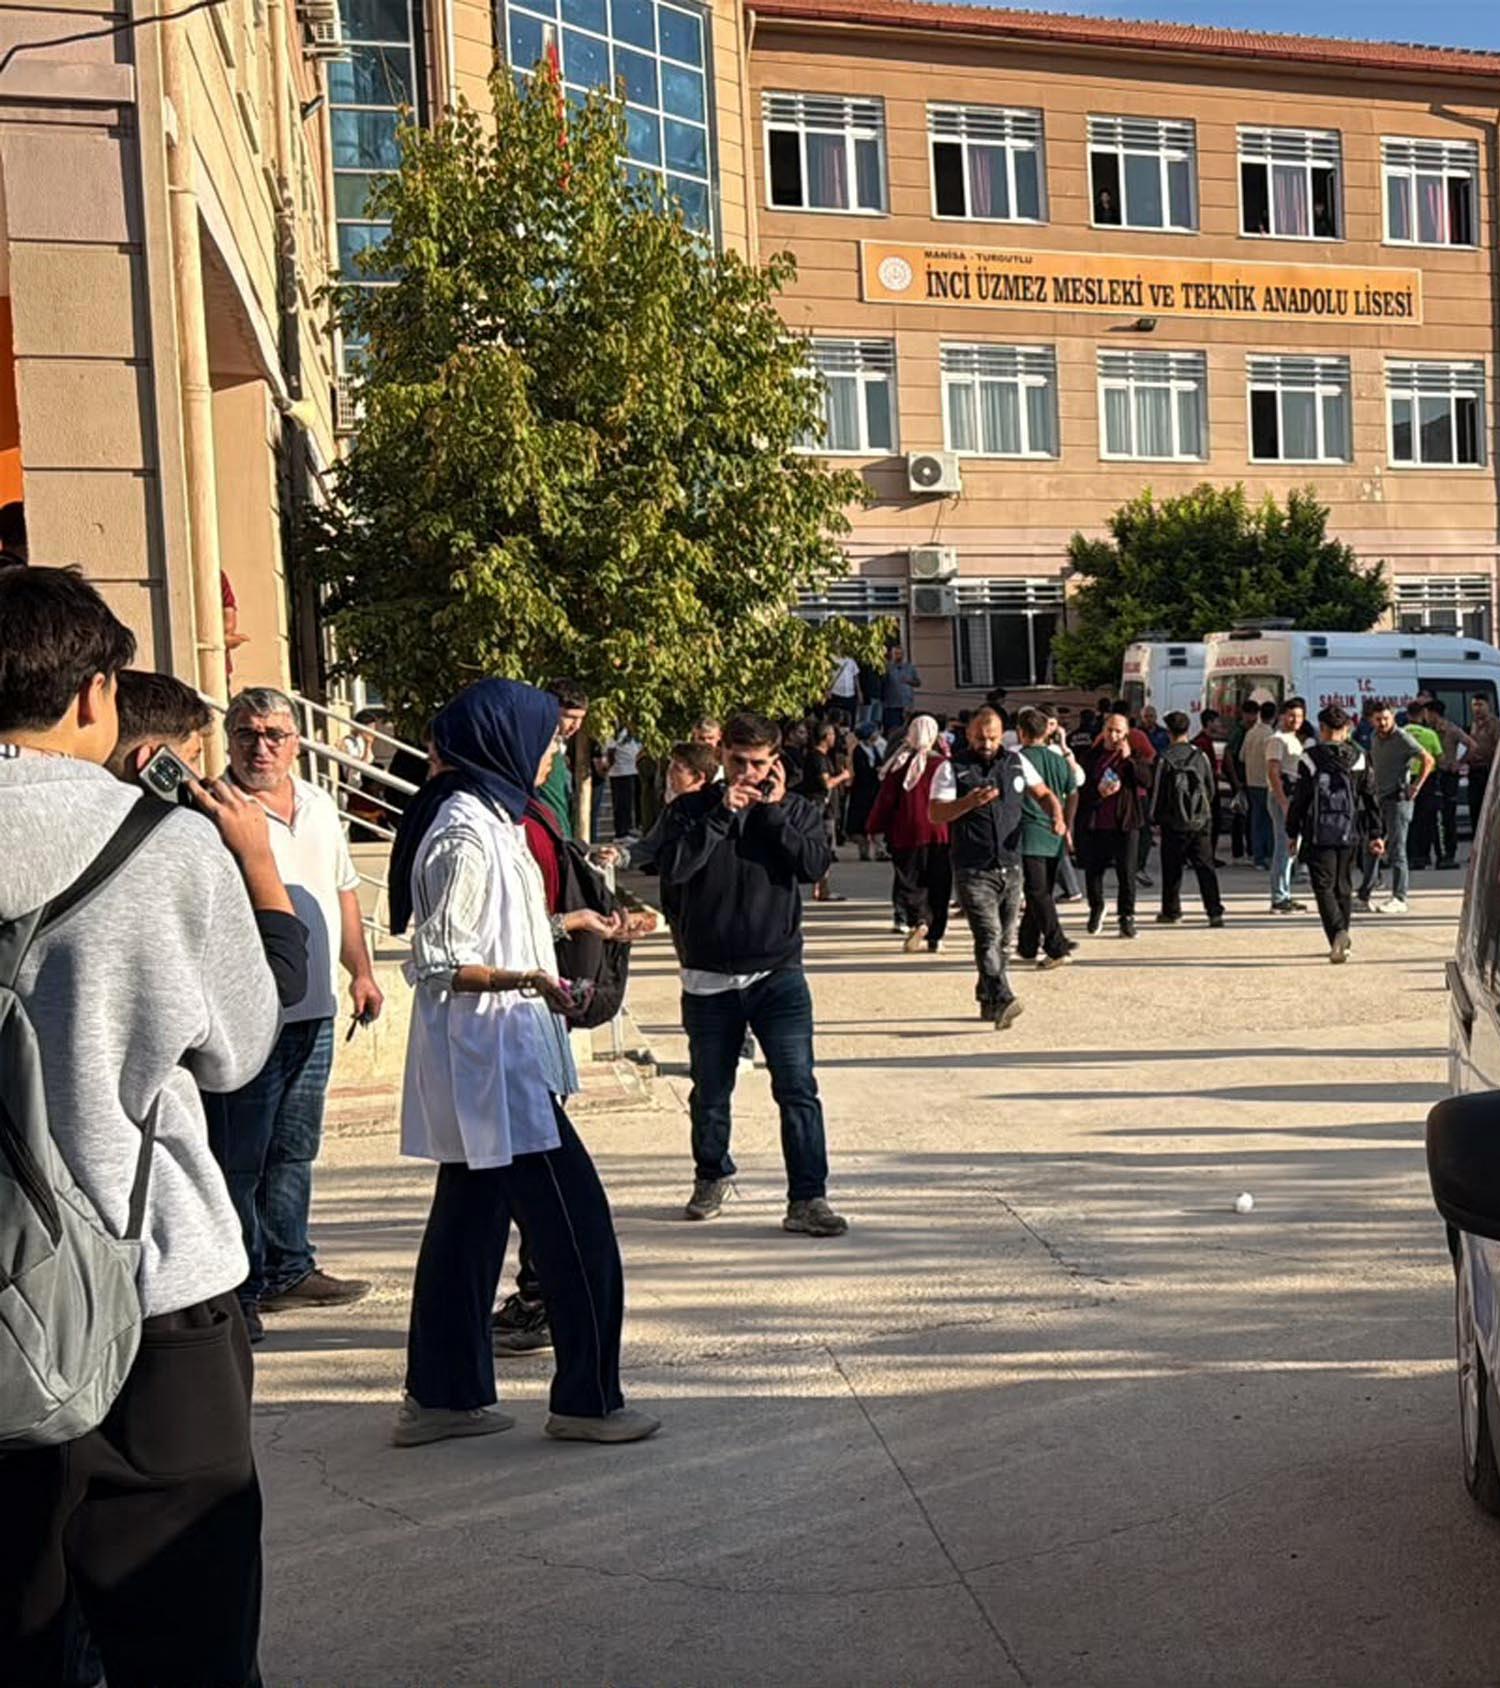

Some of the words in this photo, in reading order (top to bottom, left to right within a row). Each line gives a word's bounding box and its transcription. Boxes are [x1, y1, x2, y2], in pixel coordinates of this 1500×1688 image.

[926, 263, 971, 299] İNCİ
[976, 267, 1048, 303] ÜZMEZ
[1053, 273, 1144, 307] MESLEKİ
[1148, 284, 1175, 308] VE
[1181, 278, 1257, 312] TEKNİK
[1262, 285, 1349, 316] ANADOLU
[1354, 284, 1412, 317] LİSESİ
[1215, 654, 1269, 668] AMBULANS
[1319, 691, 1357, 708] SAĞLIK
